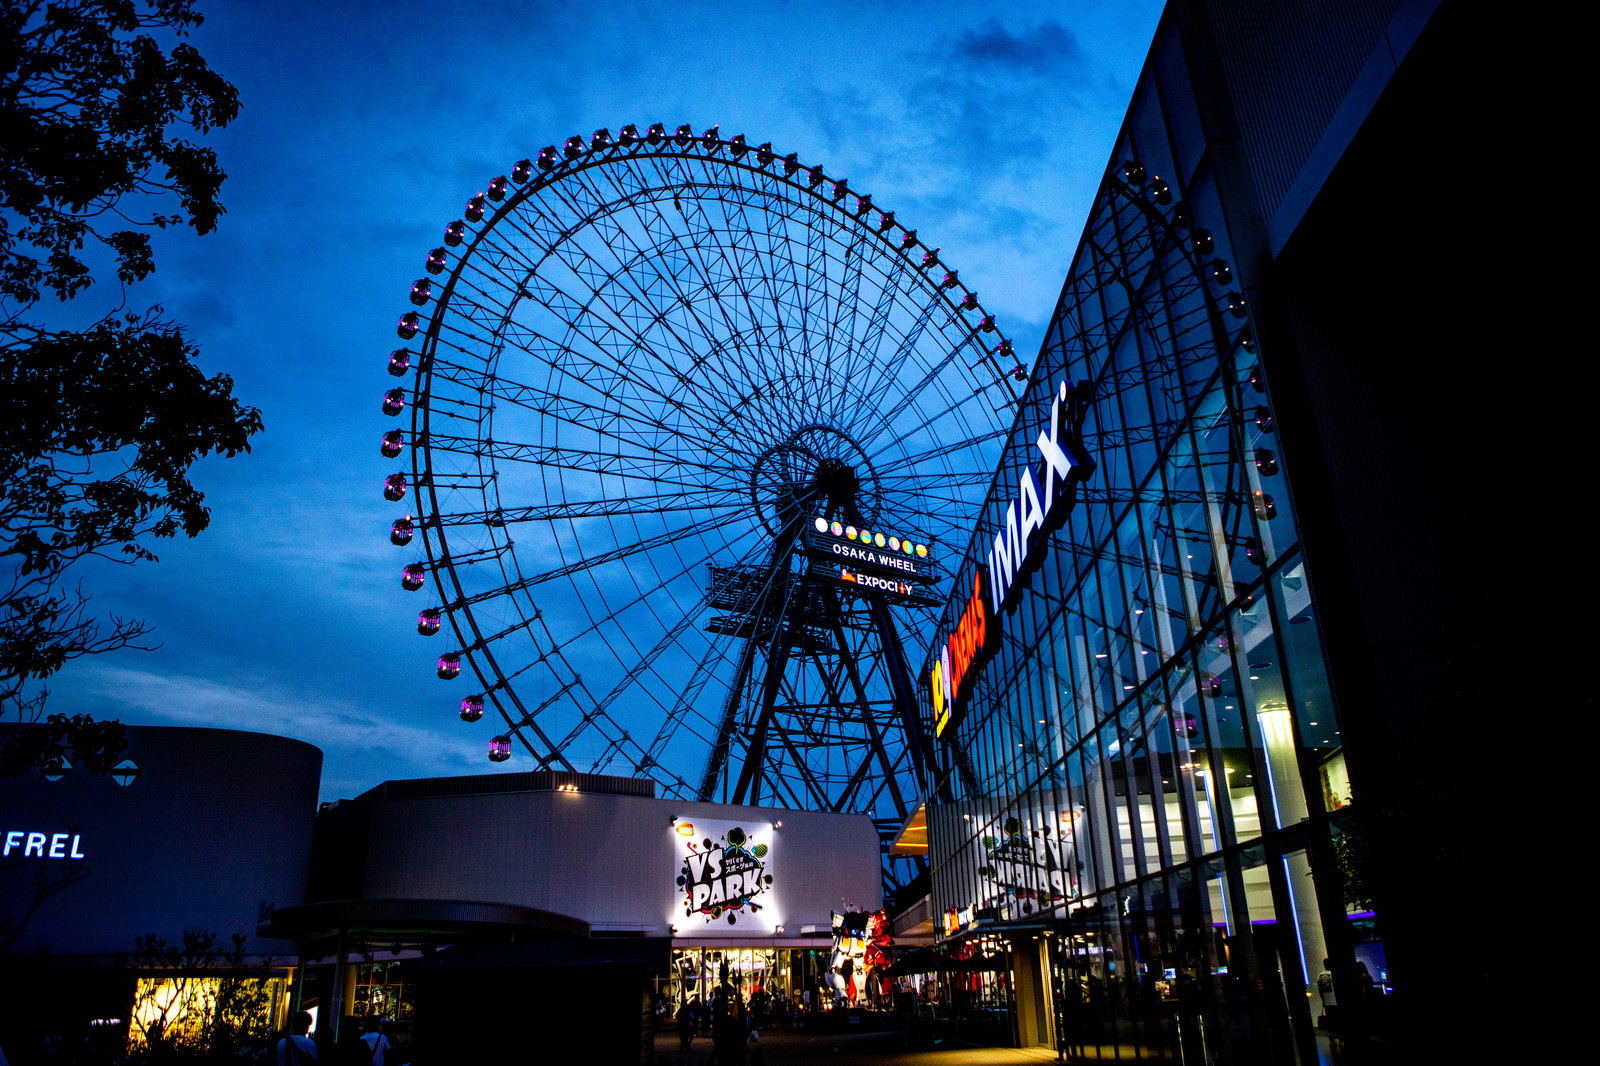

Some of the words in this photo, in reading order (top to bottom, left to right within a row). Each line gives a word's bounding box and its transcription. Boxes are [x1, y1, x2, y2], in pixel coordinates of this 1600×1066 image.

[988, 383, 1072, 616] IMAX
[832, 544, 876, 563] OSAKA
[878, 554, 917, 573] WHEEL
[0, 831, 85, 859] FREL
[688, 849, 723, 883] VS
[692, 868, 762, 912] PARK
